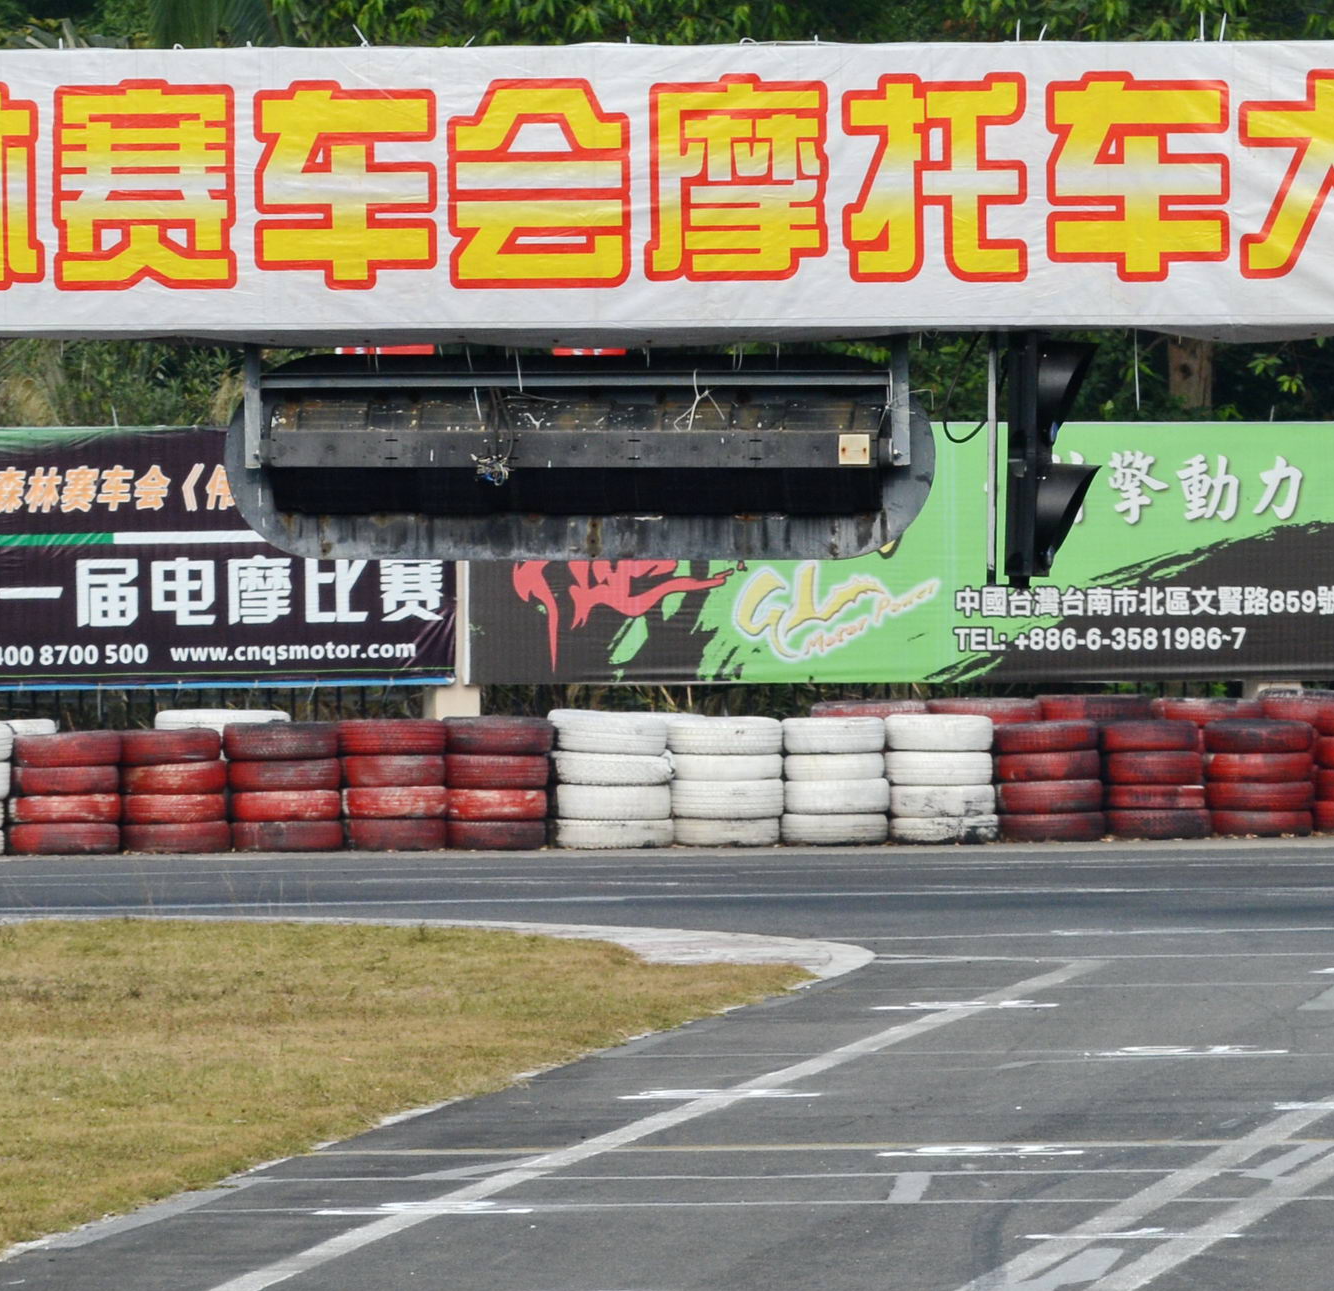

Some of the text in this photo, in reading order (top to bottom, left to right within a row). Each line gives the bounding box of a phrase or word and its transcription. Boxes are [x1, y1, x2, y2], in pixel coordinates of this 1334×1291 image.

[954, 627, 1007, 652] TEL:
[39, 644, 99, 666] 8700
[104, 643, 149, 665] 500
[170, 640, 417, 666] www.cnqsmotor.com
